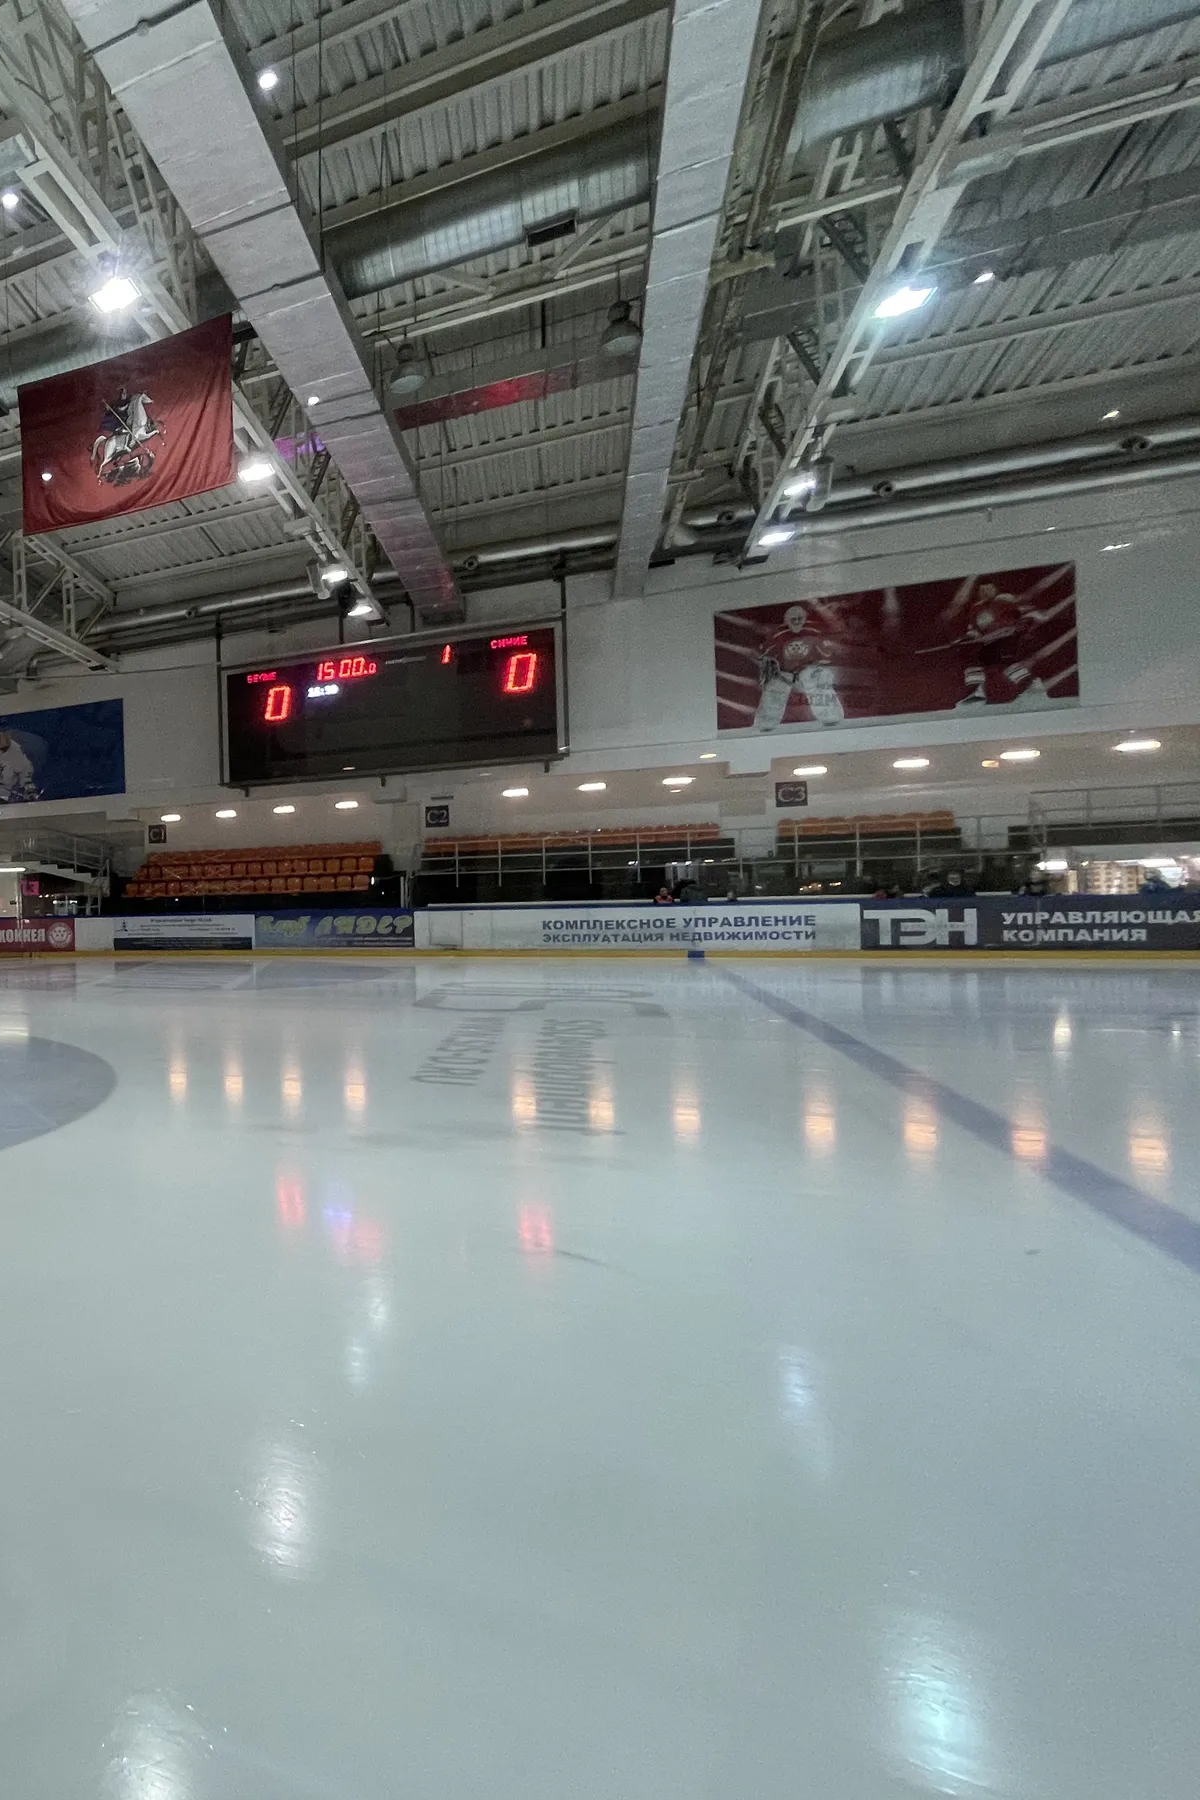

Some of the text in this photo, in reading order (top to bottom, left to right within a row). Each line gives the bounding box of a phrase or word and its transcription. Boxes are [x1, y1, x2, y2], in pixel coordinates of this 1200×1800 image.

[441, 644, 451, 664] 1
[505, 653, 537, 692] 0
[264, 686, 291, 721] 0
[542, 914, 817, 931] КОМПЛЕКСНОЕ УПРАВЛЕНИЕ
[1001, 909, 1200, 925] УПРАВЛЯЮЩАЯ
[542, 929, 817, 943] ЭКСПЛУАТАЦИЯ НЕДВИЖИМОСТИ
[863, 908, 978, 946] ТЭН
[1002, 928, 1147, 942] КОМПАНИЯ
